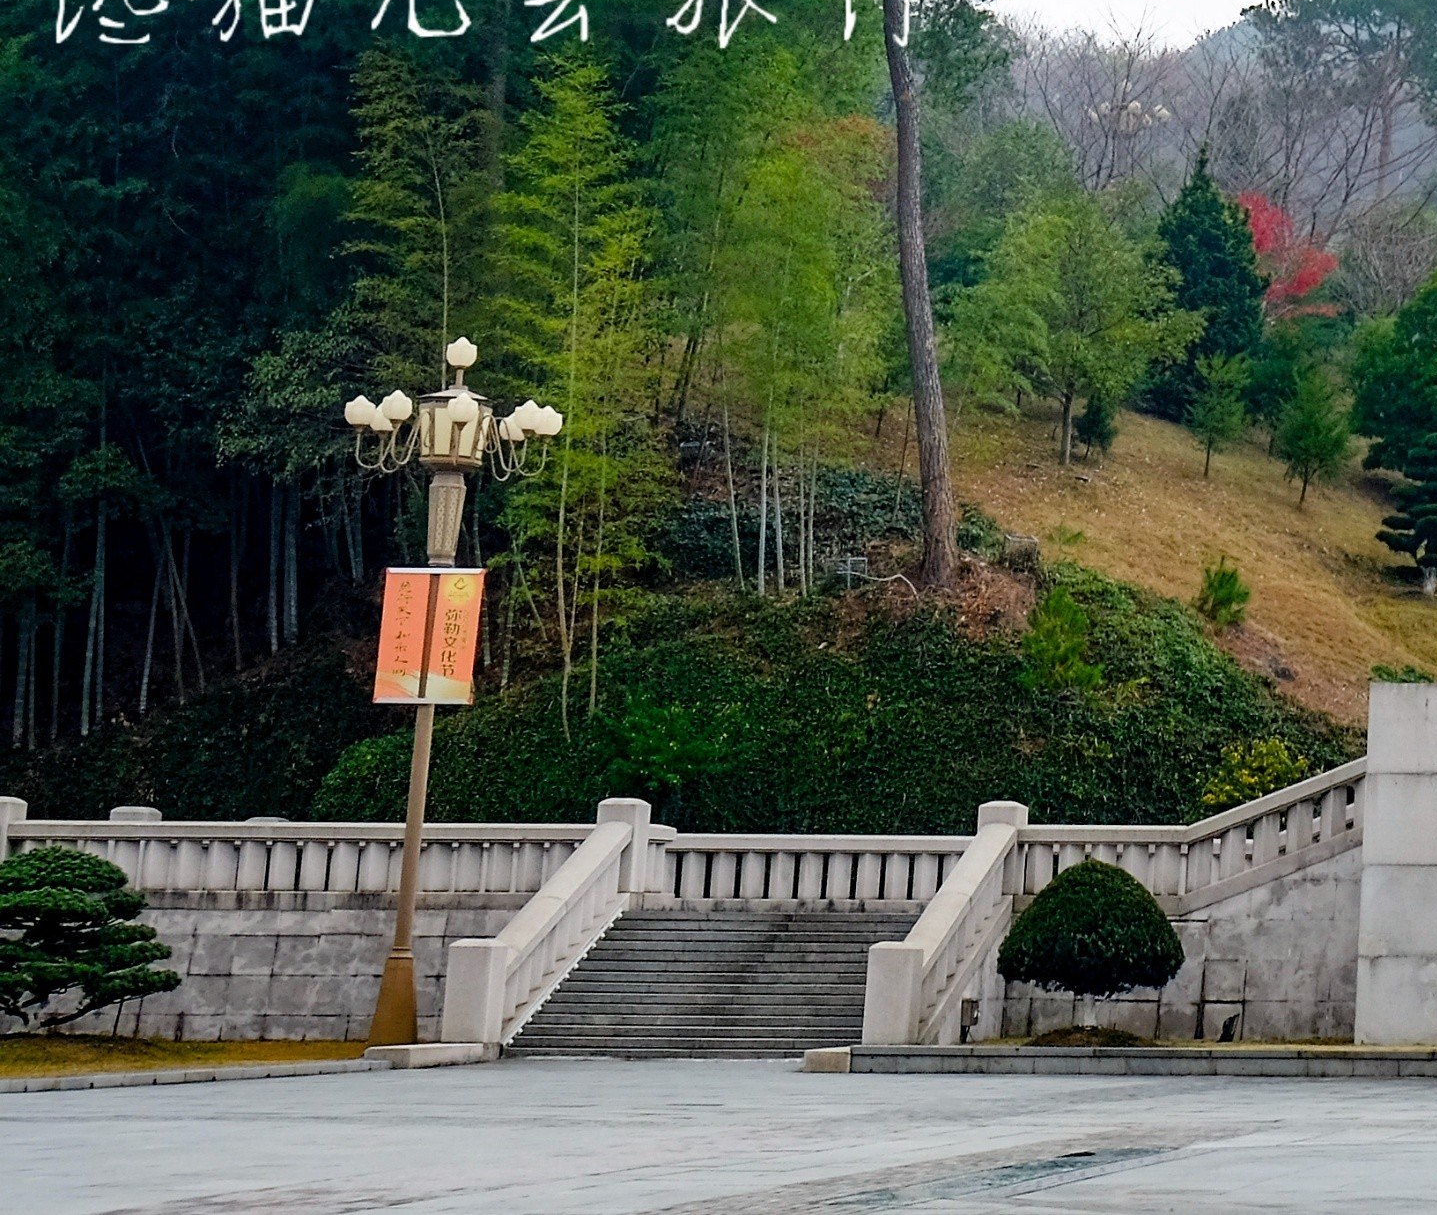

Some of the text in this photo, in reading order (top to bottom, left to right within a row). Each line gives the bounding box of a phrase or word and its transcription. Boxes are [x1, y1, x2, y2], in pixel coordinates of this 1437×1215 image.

[441, 608, 463, 677] 弥勒文化节
